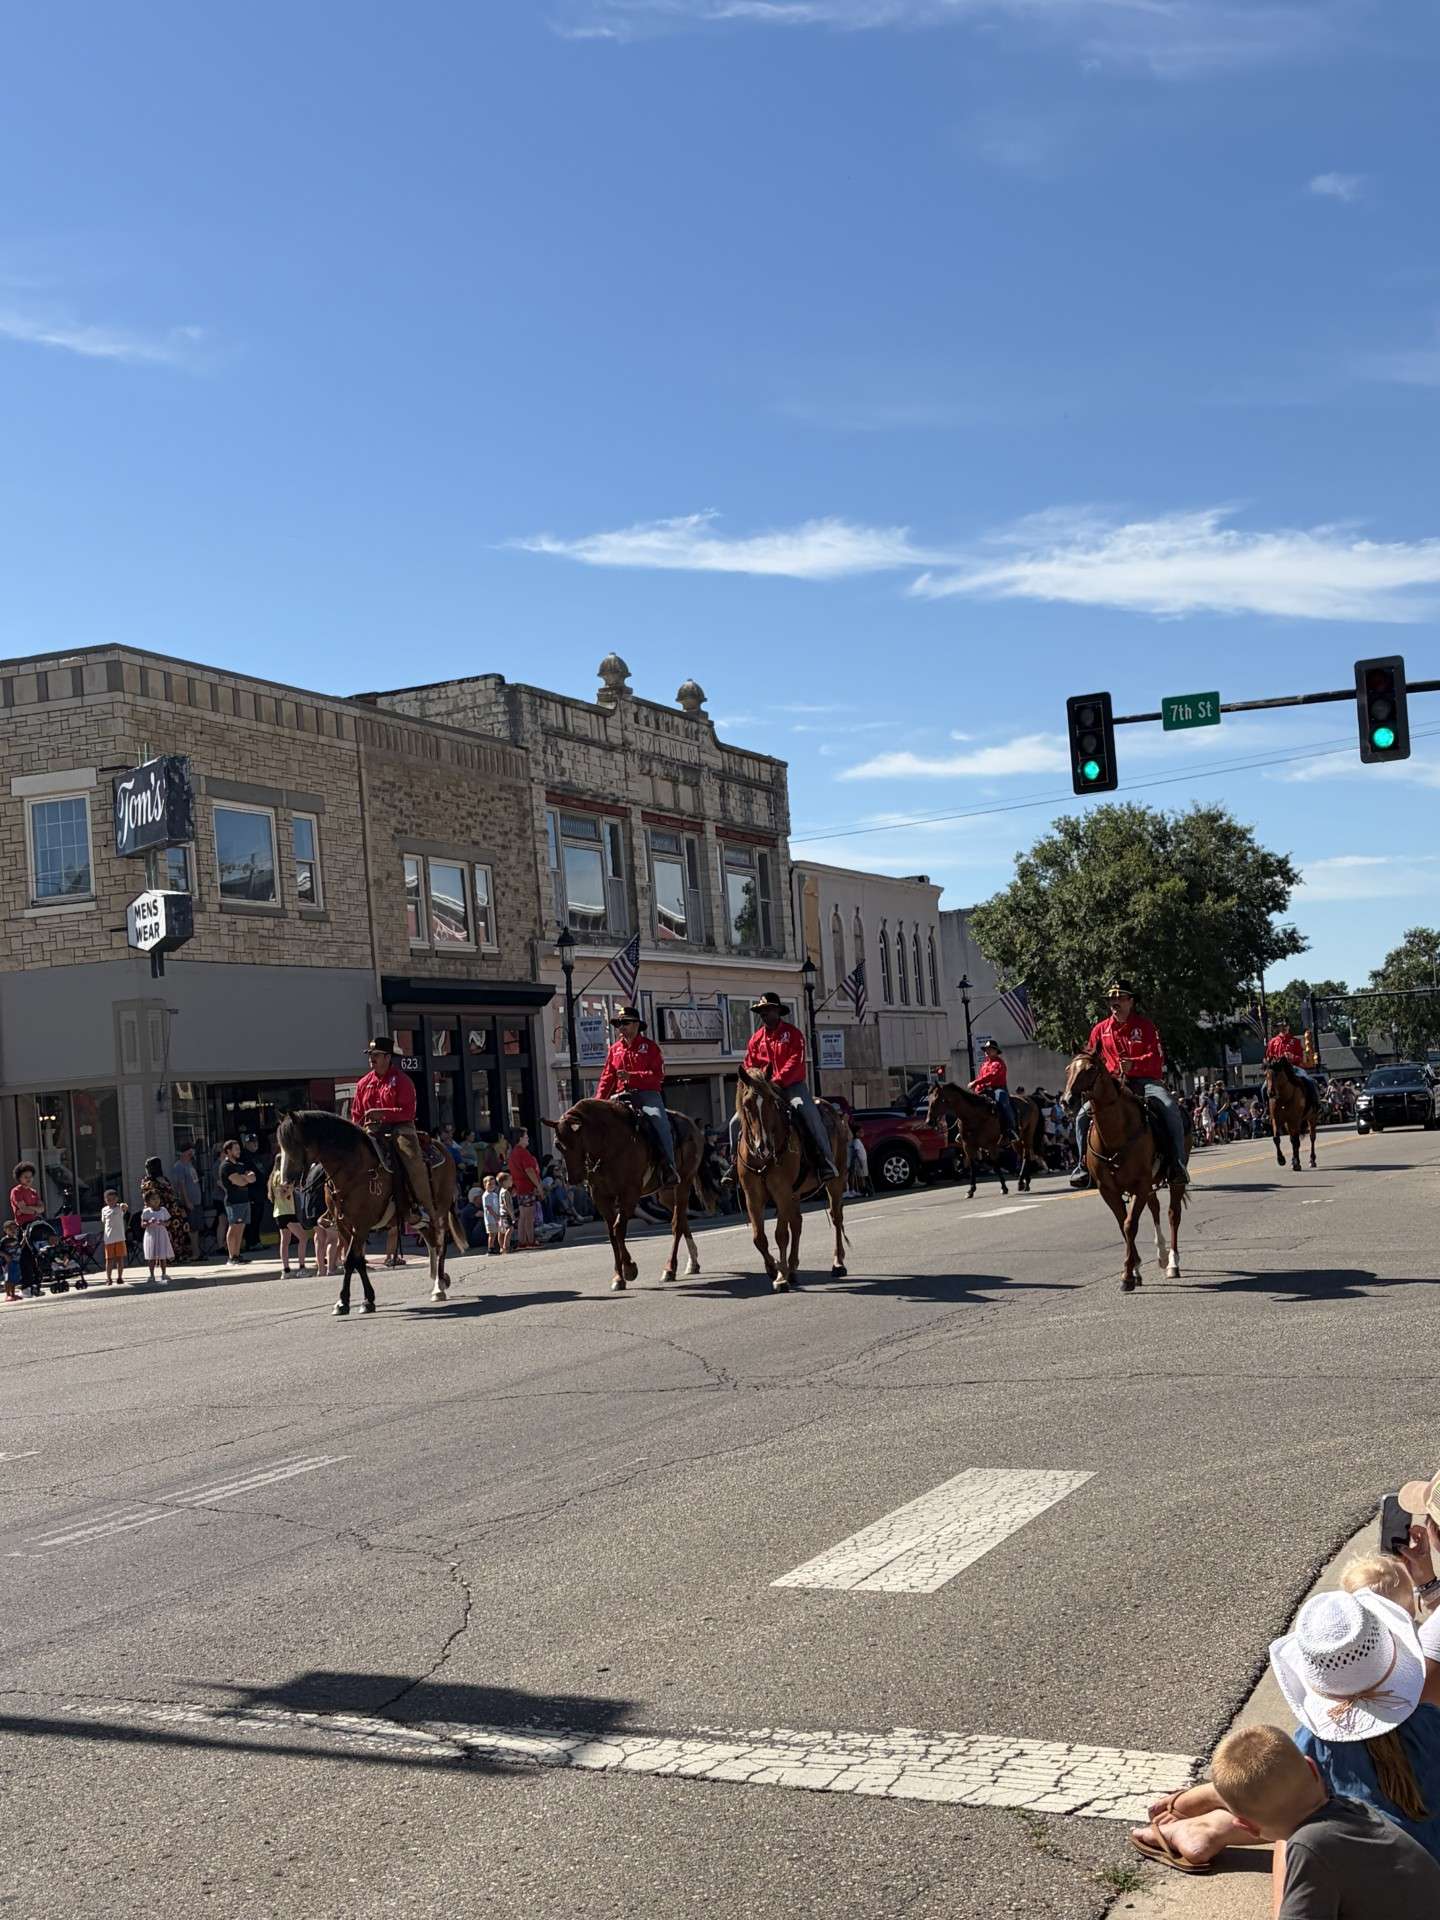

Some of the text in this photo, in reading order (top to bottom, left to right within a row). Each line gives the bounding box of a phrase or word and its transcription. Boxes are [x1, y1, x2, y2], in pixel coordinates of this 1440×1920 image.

[1170, 701, 1212, 722] 7th St
[117, 772, 165, 848] Tom's
[134, 900, 158, 922] MENS
[135, 925, 160, 944] WEAR
[401, 1057, 418, 1070] 623
